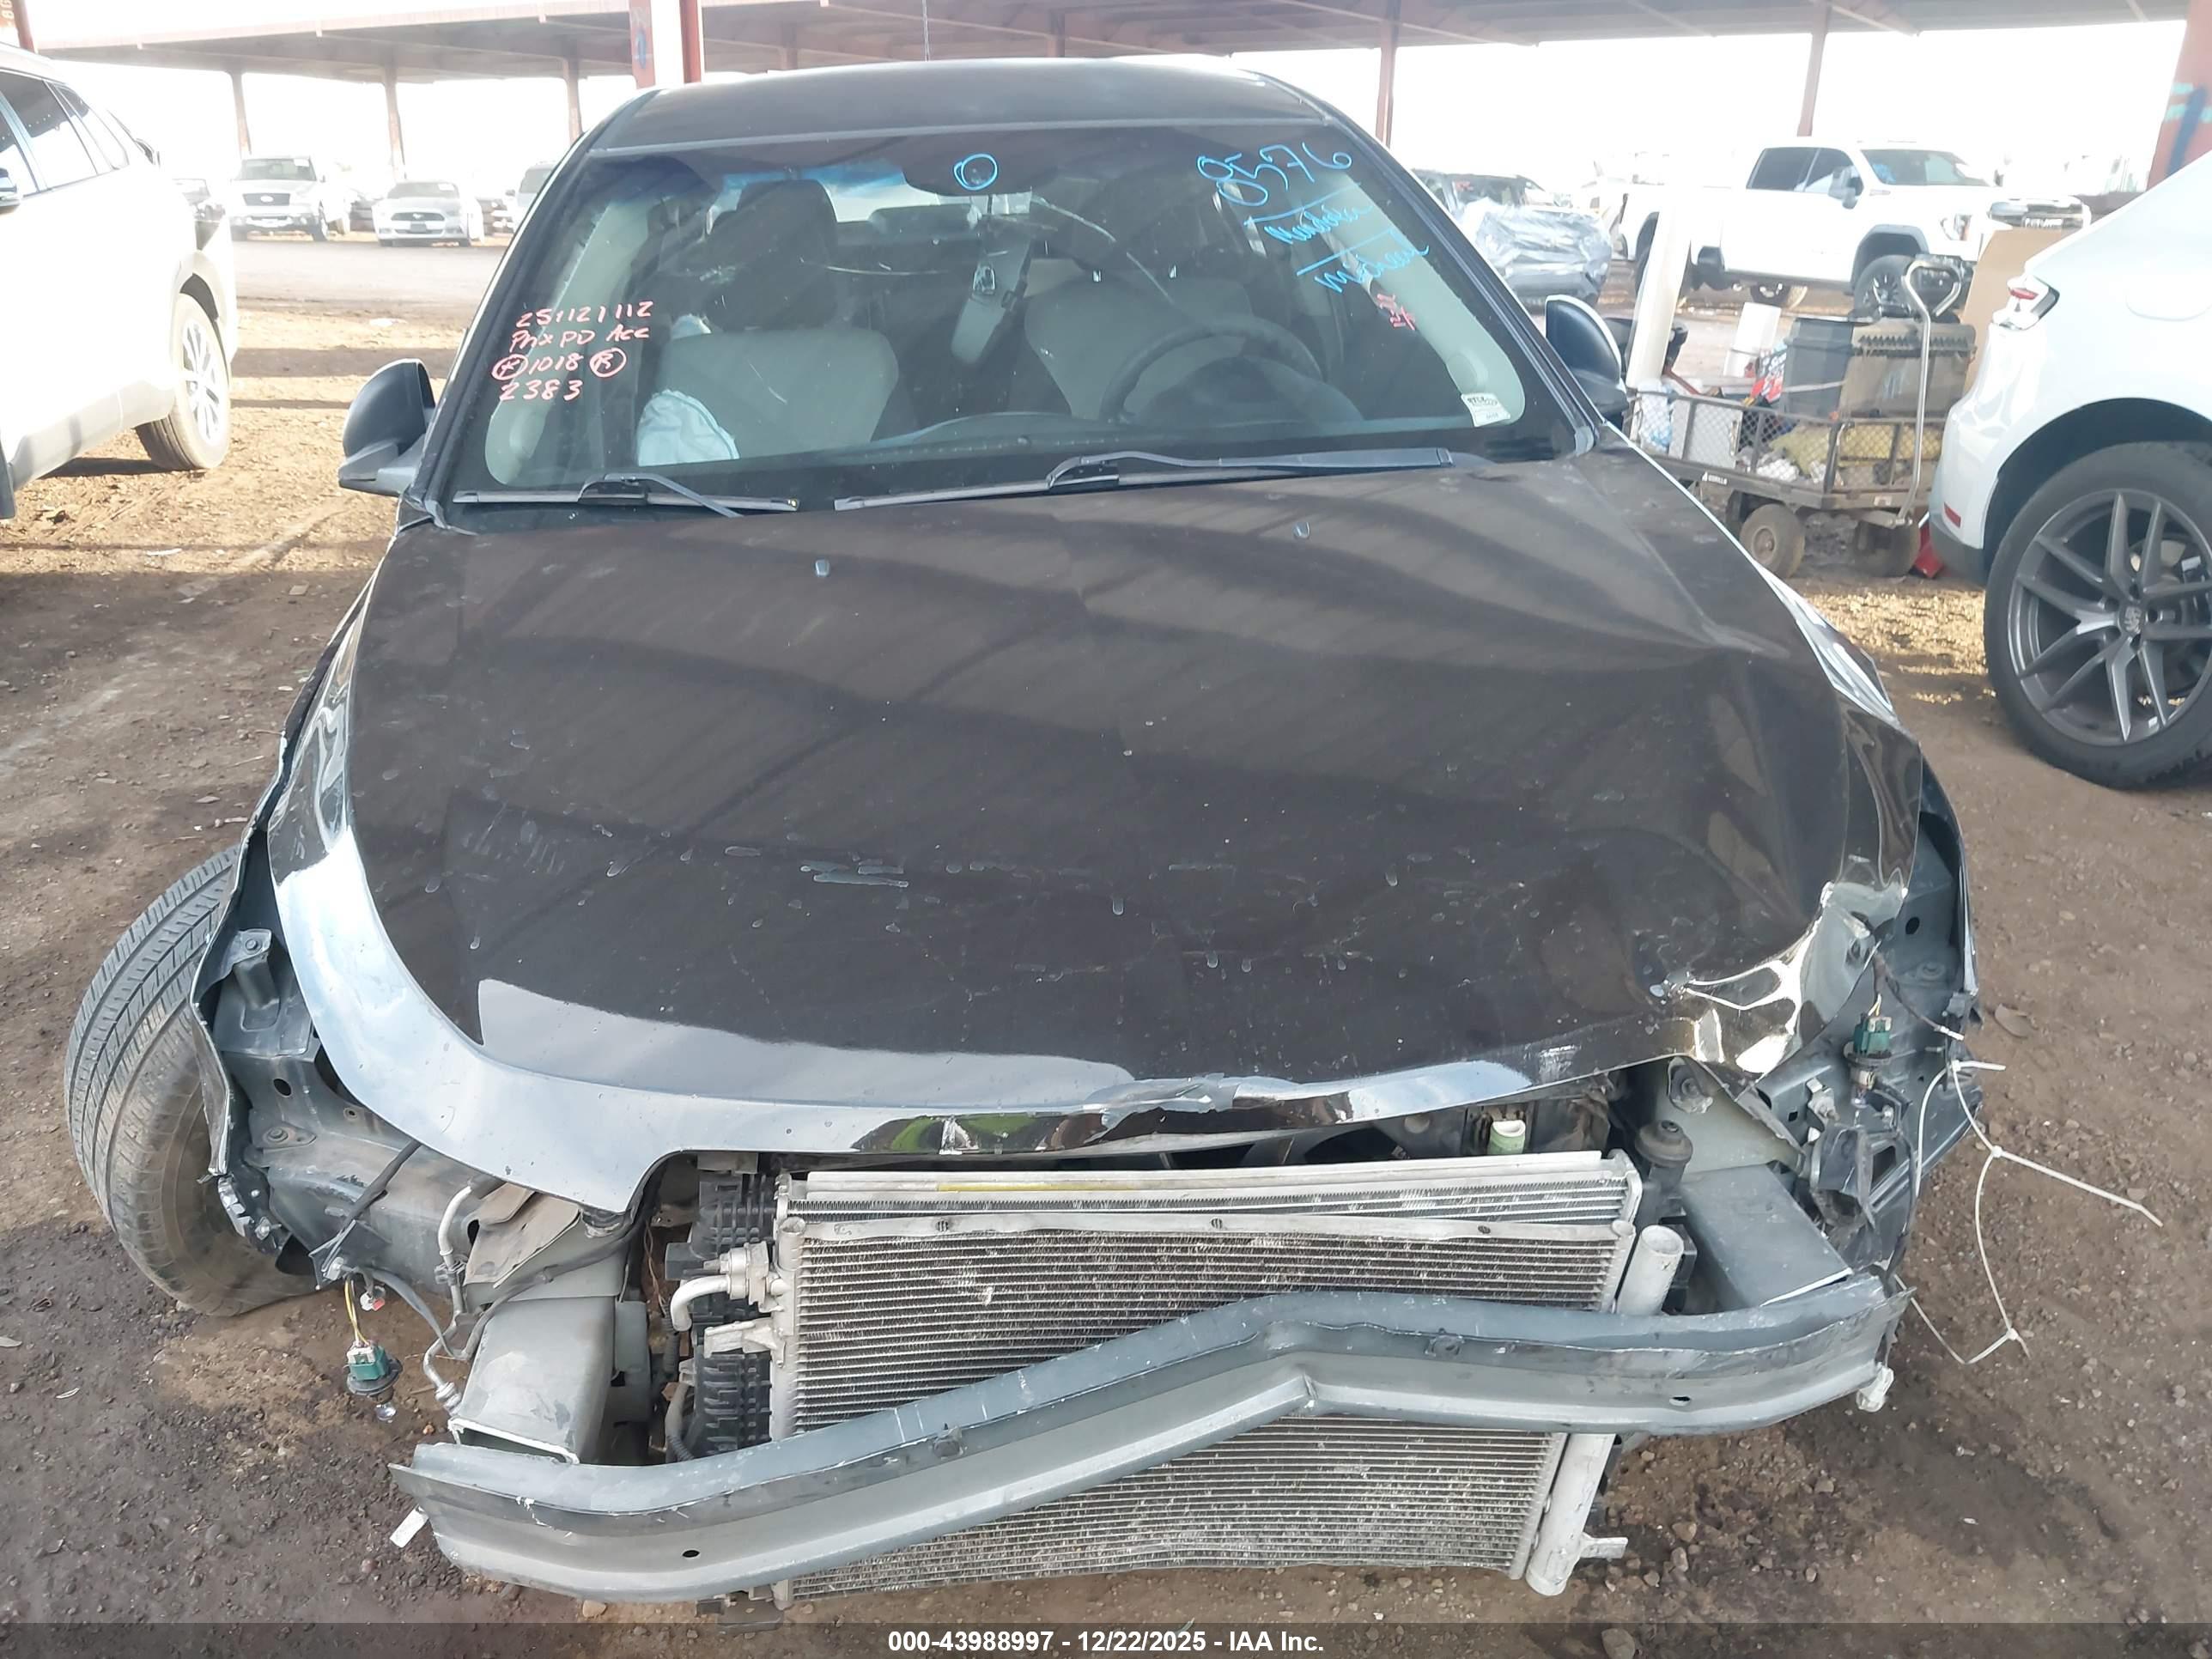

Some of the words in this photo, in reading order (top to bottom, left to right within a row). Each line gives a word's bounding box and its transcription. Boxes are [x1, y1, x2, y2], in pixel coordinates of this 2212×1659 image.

[560, 330, 595, 348] PD
[529, 353, 584, 375] 1018
[499, 380, 584, 401] 2383
